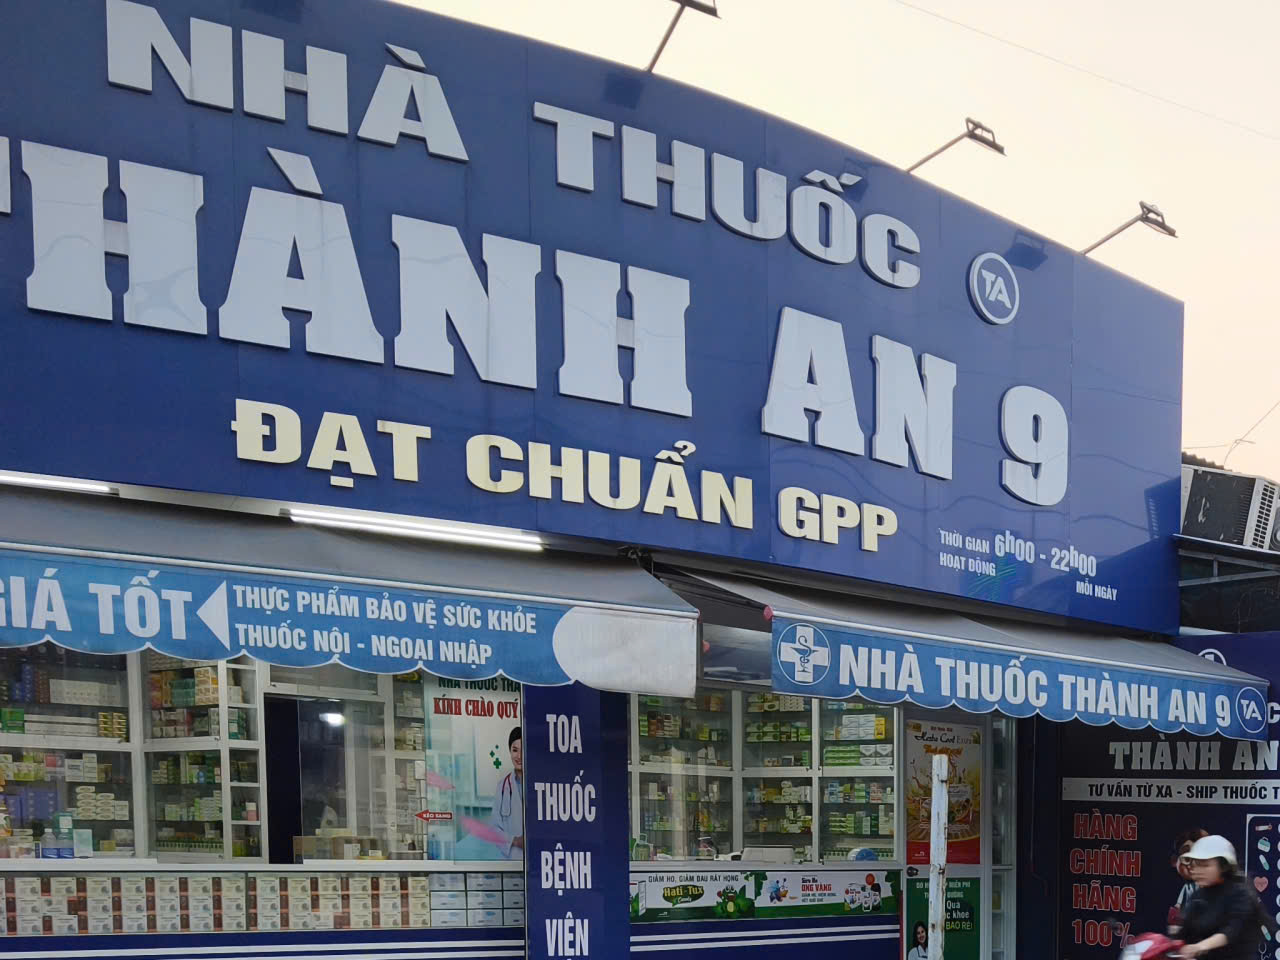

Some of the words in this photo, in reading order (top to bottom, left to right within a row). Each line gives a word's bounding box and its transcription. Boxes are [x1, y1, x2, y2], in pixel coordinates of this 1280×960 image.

[106, 0, 469, 162] NHÀ
[533, 101, 922, 289] THUỐC
[0, 136, 693, 417] HÀNH
[761, 306, 957, 481] AN
[1001, 385, 1070, 506] 9
[231, 397, 432, 488] ĐẠT
[466, 440, 754, 531] CHUẨN
[777, 486, 899, 552] GPP
[939, 529, 963, 549] THỜI
[965, 536, 990, 554] GIAN
[994, 530, 1035, 564] 6h00
[1050, 545, 1097, 577] 22h00
[939, 552, 966, 572] HOẠT
[968, 556, 996, 577] ĐỘNG
[0, 568, 72, 633] IÁ
[88, 570, 193, 641] TỐT
[233, 584, 290, 615] THỰC
[296, 585, 359, 617] PHẨM
[366, 592, 408, 622] BẢO
[411, 598, 437, 632] VỆ
[443, 599, 482, 630] SỨC
[488, 604, 537, 635] KHỎE
[1076, 577, 1093, 597] MỖI
[1094, 584, 1118, 601] NGÀY
[235, 620, 307, 650] THUỐC
[313, 627, 351, 658] NỘI
[371, 635, 433, 663] NGOẠI
[439, 638, 493, 669] NHẬP
[433, 694, 463, 715] KÍNH
[465, 696, 494, 717] CHÀO
[497, 698, 519, 719] QUÝ
[839, 644, 925, 694] NHÀ
[935, 654, 1049, 707] THUỐC
[1058, 672, 1159, 721] THÀNH
[1168, 688, 1208, 725] AN
[1216, 697, 1231, 727] 9
[546, 713, 583, 754] TOA
[1108, 733, 1221, 771] THÀNH
[1232, 740, 1279, 771] AN
[534, 770, 596, 822] THUỐC
[1088, 782, 1105, 797] TƯ
[1107, 780, 1132, 798] VẤN
[1136, 782, 1154, 799] TỪ
[1156, 784, 1173, 799] XA
[1186, 785, 1218, 800] SHIP
[1222, 781, 1268, 801] THUỐC
[1073, 808, 1138, 841] HÀNG
[541, 843, 592, 896] BỆNH
[1069, 844, 1141, 877] CHÍNH
[1072, 880, 1137, 913] HÃNG
[1072, 918, 1136, 949] 100%
